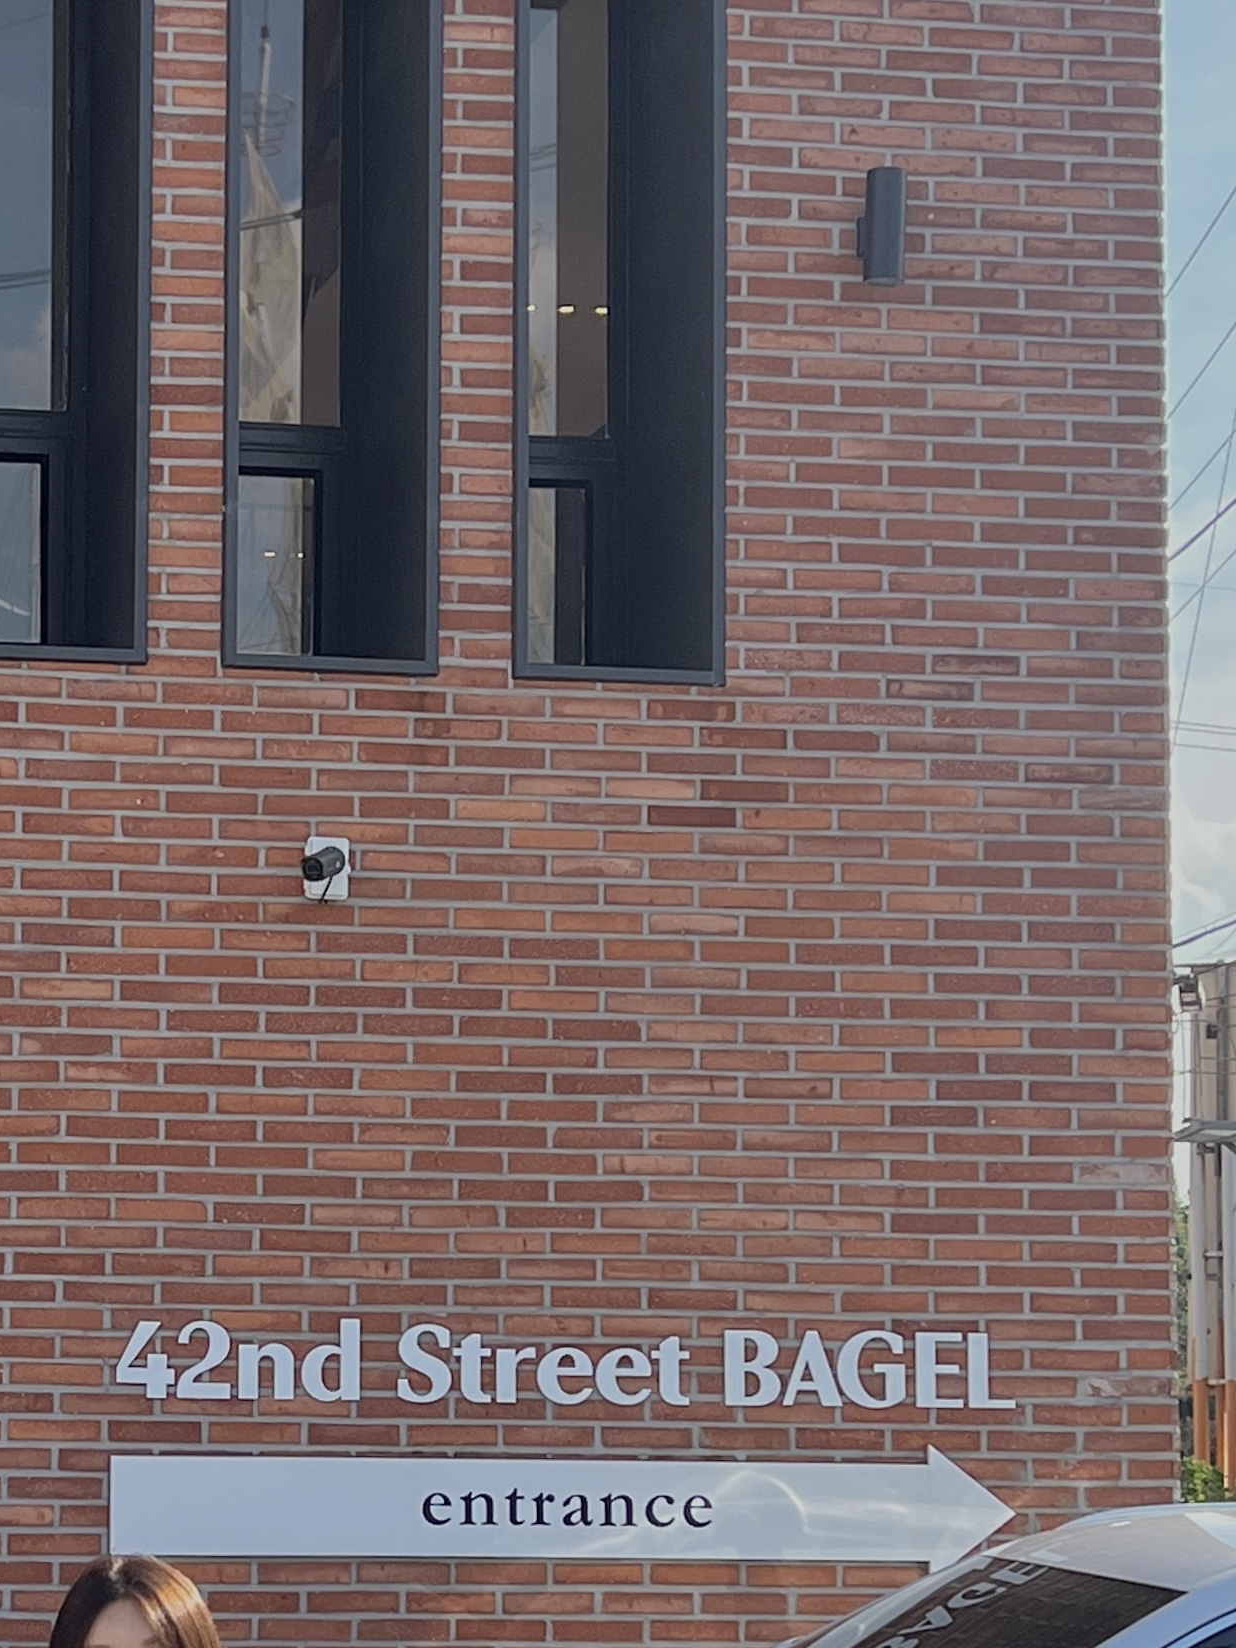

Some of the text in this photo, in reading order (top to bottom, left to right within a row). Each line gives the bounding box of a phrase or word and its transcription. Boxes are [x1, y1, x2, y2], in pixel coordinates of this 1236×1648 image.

[115, 1318, 1017, 1409] 42nd Street BAGEL
[421, 1487, 714, 1528] entrance
